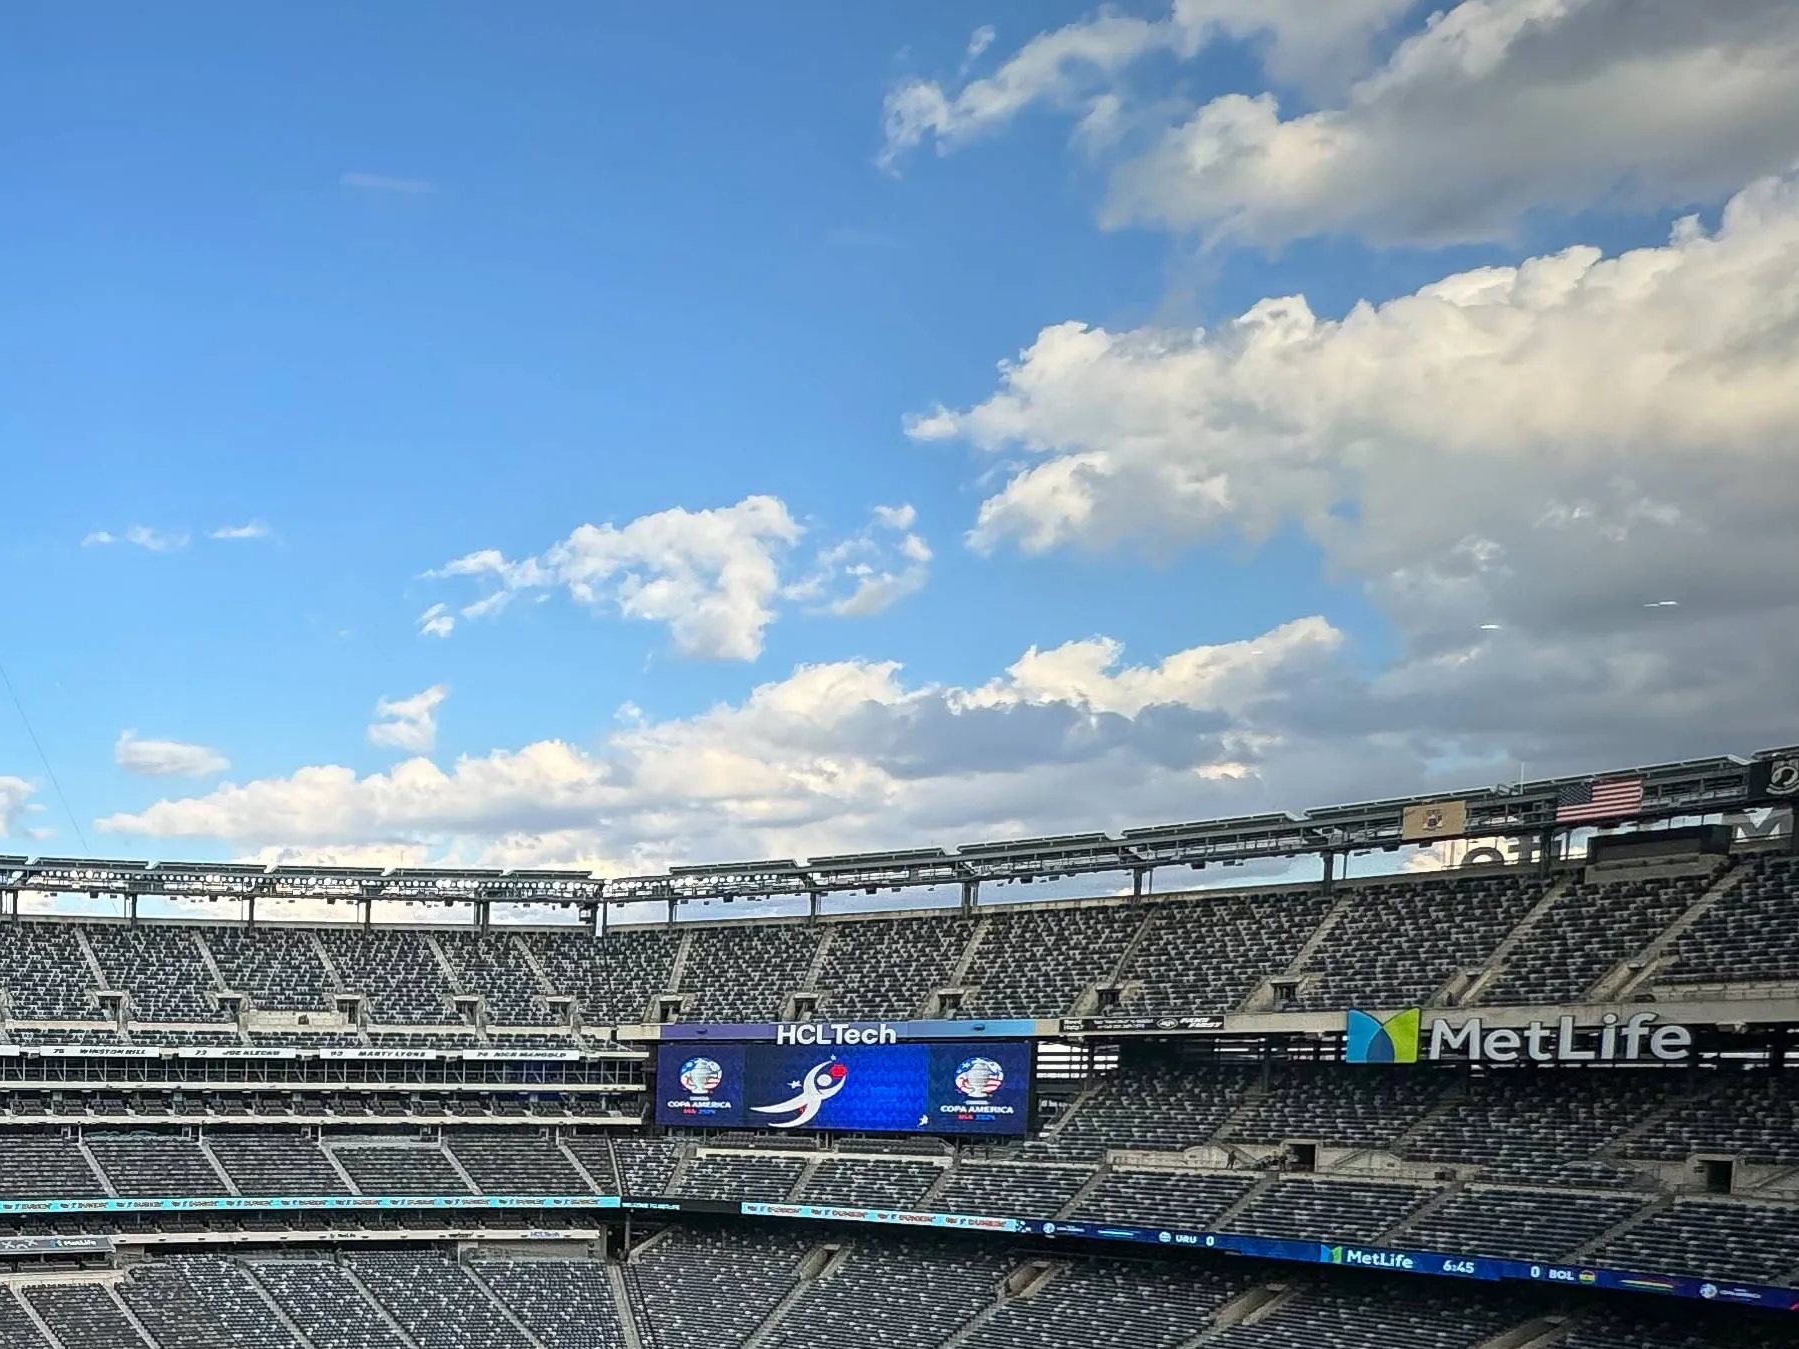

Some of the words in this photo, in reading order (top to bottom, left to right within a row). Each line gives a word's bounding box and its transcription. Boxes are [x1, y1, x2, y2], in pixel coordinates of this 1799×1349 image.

[776, 1023, 897, 1045] HCLTech
[1429, 1011, 1692, 1062] MetLife
[667, 1100, 691, 1108] COPA
[692, 1101, 732, 1109] AMERICA
[940, 1105, 968, 1113] COPA
[968, 1105, 1014, 1114] AMERICA
[1175, 1235, 1197, 1244] URU
[1206, 1235, 1215, 1247] 0
[1347, 1250, 1414, 1269] MetLife
[1442, 1259, 1475, 1274] 6:45
[1530, 1265, 1541, 1278] 0
[1549, 1268, 1575, 1281] BOL
